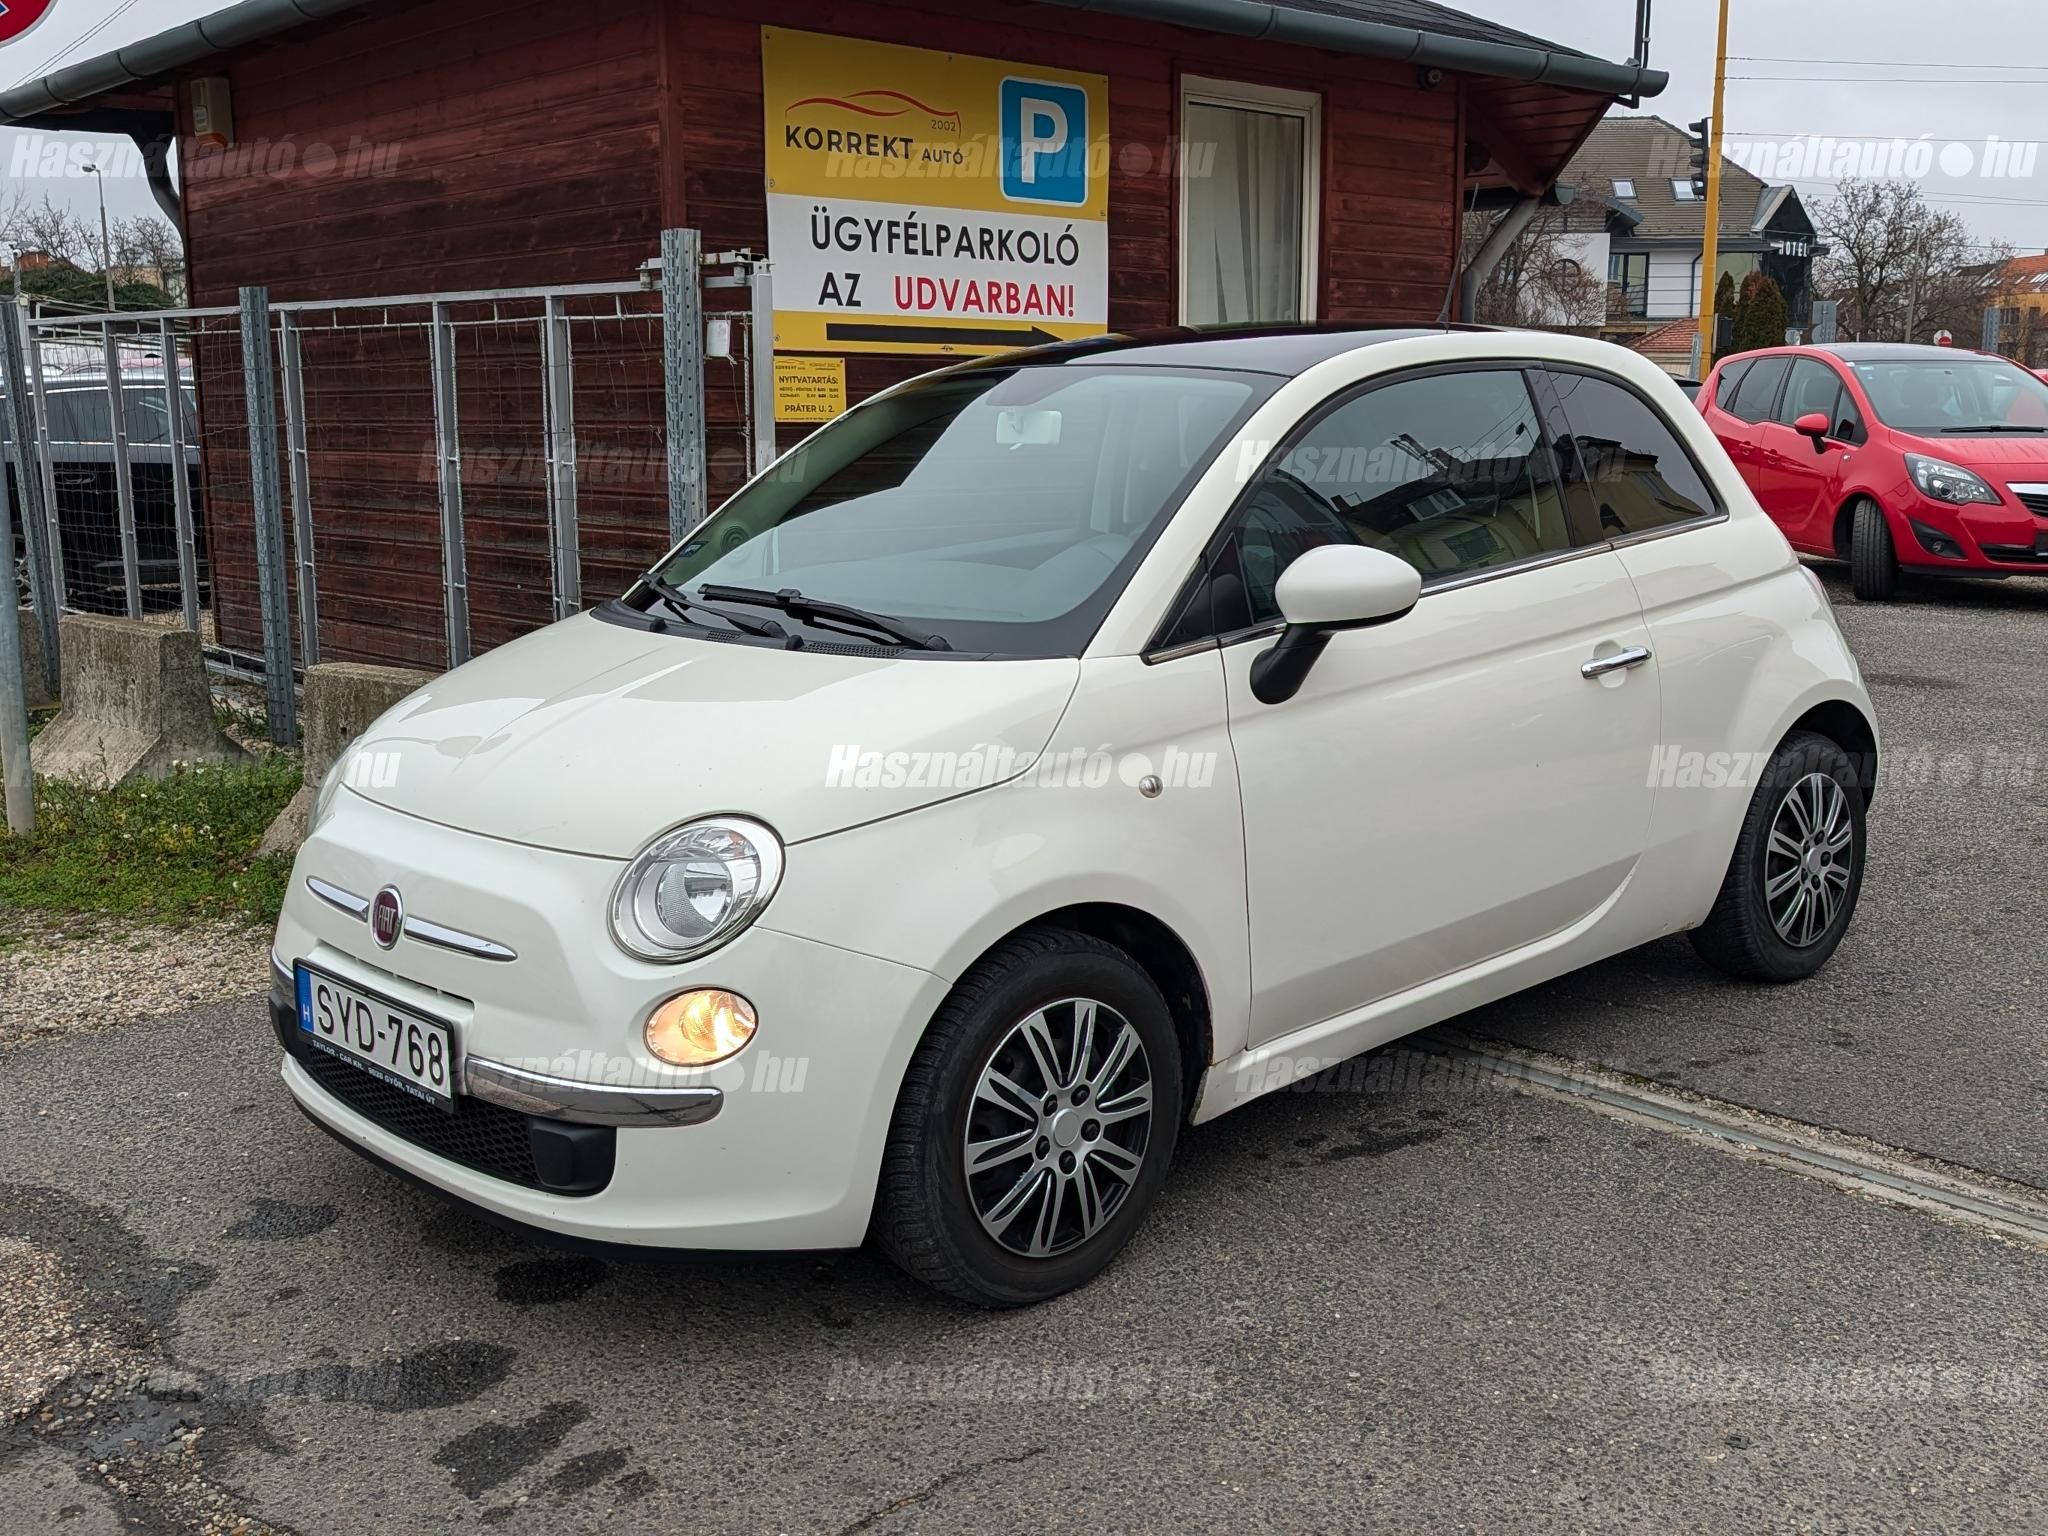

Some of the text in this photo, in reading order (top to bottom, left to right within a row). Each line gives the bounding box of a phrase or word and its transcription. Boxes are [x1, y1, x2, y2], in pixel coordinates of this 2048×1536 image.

[931, 119, 957, 132] 2002
[785, 124, 964, 165] KORREKT AUTÓ
[810, 205, 1080, 267] ÜGYFÉLPARKOLÓ
[817, 271, 1075, 317] AZ UDVARBAN!
[778, 375, 839, 385] NYITVATARTÁS:
[784, 402, 817, 413] PRÁTER
[818, 404, 827, 413] U.
[378, 904, 397, 934] FIAT
[302, 1003, 311, 1023] H
[317, 983, 444, 1086] SYD-768
[312, 1039, 336, 1057] TAYLOR
